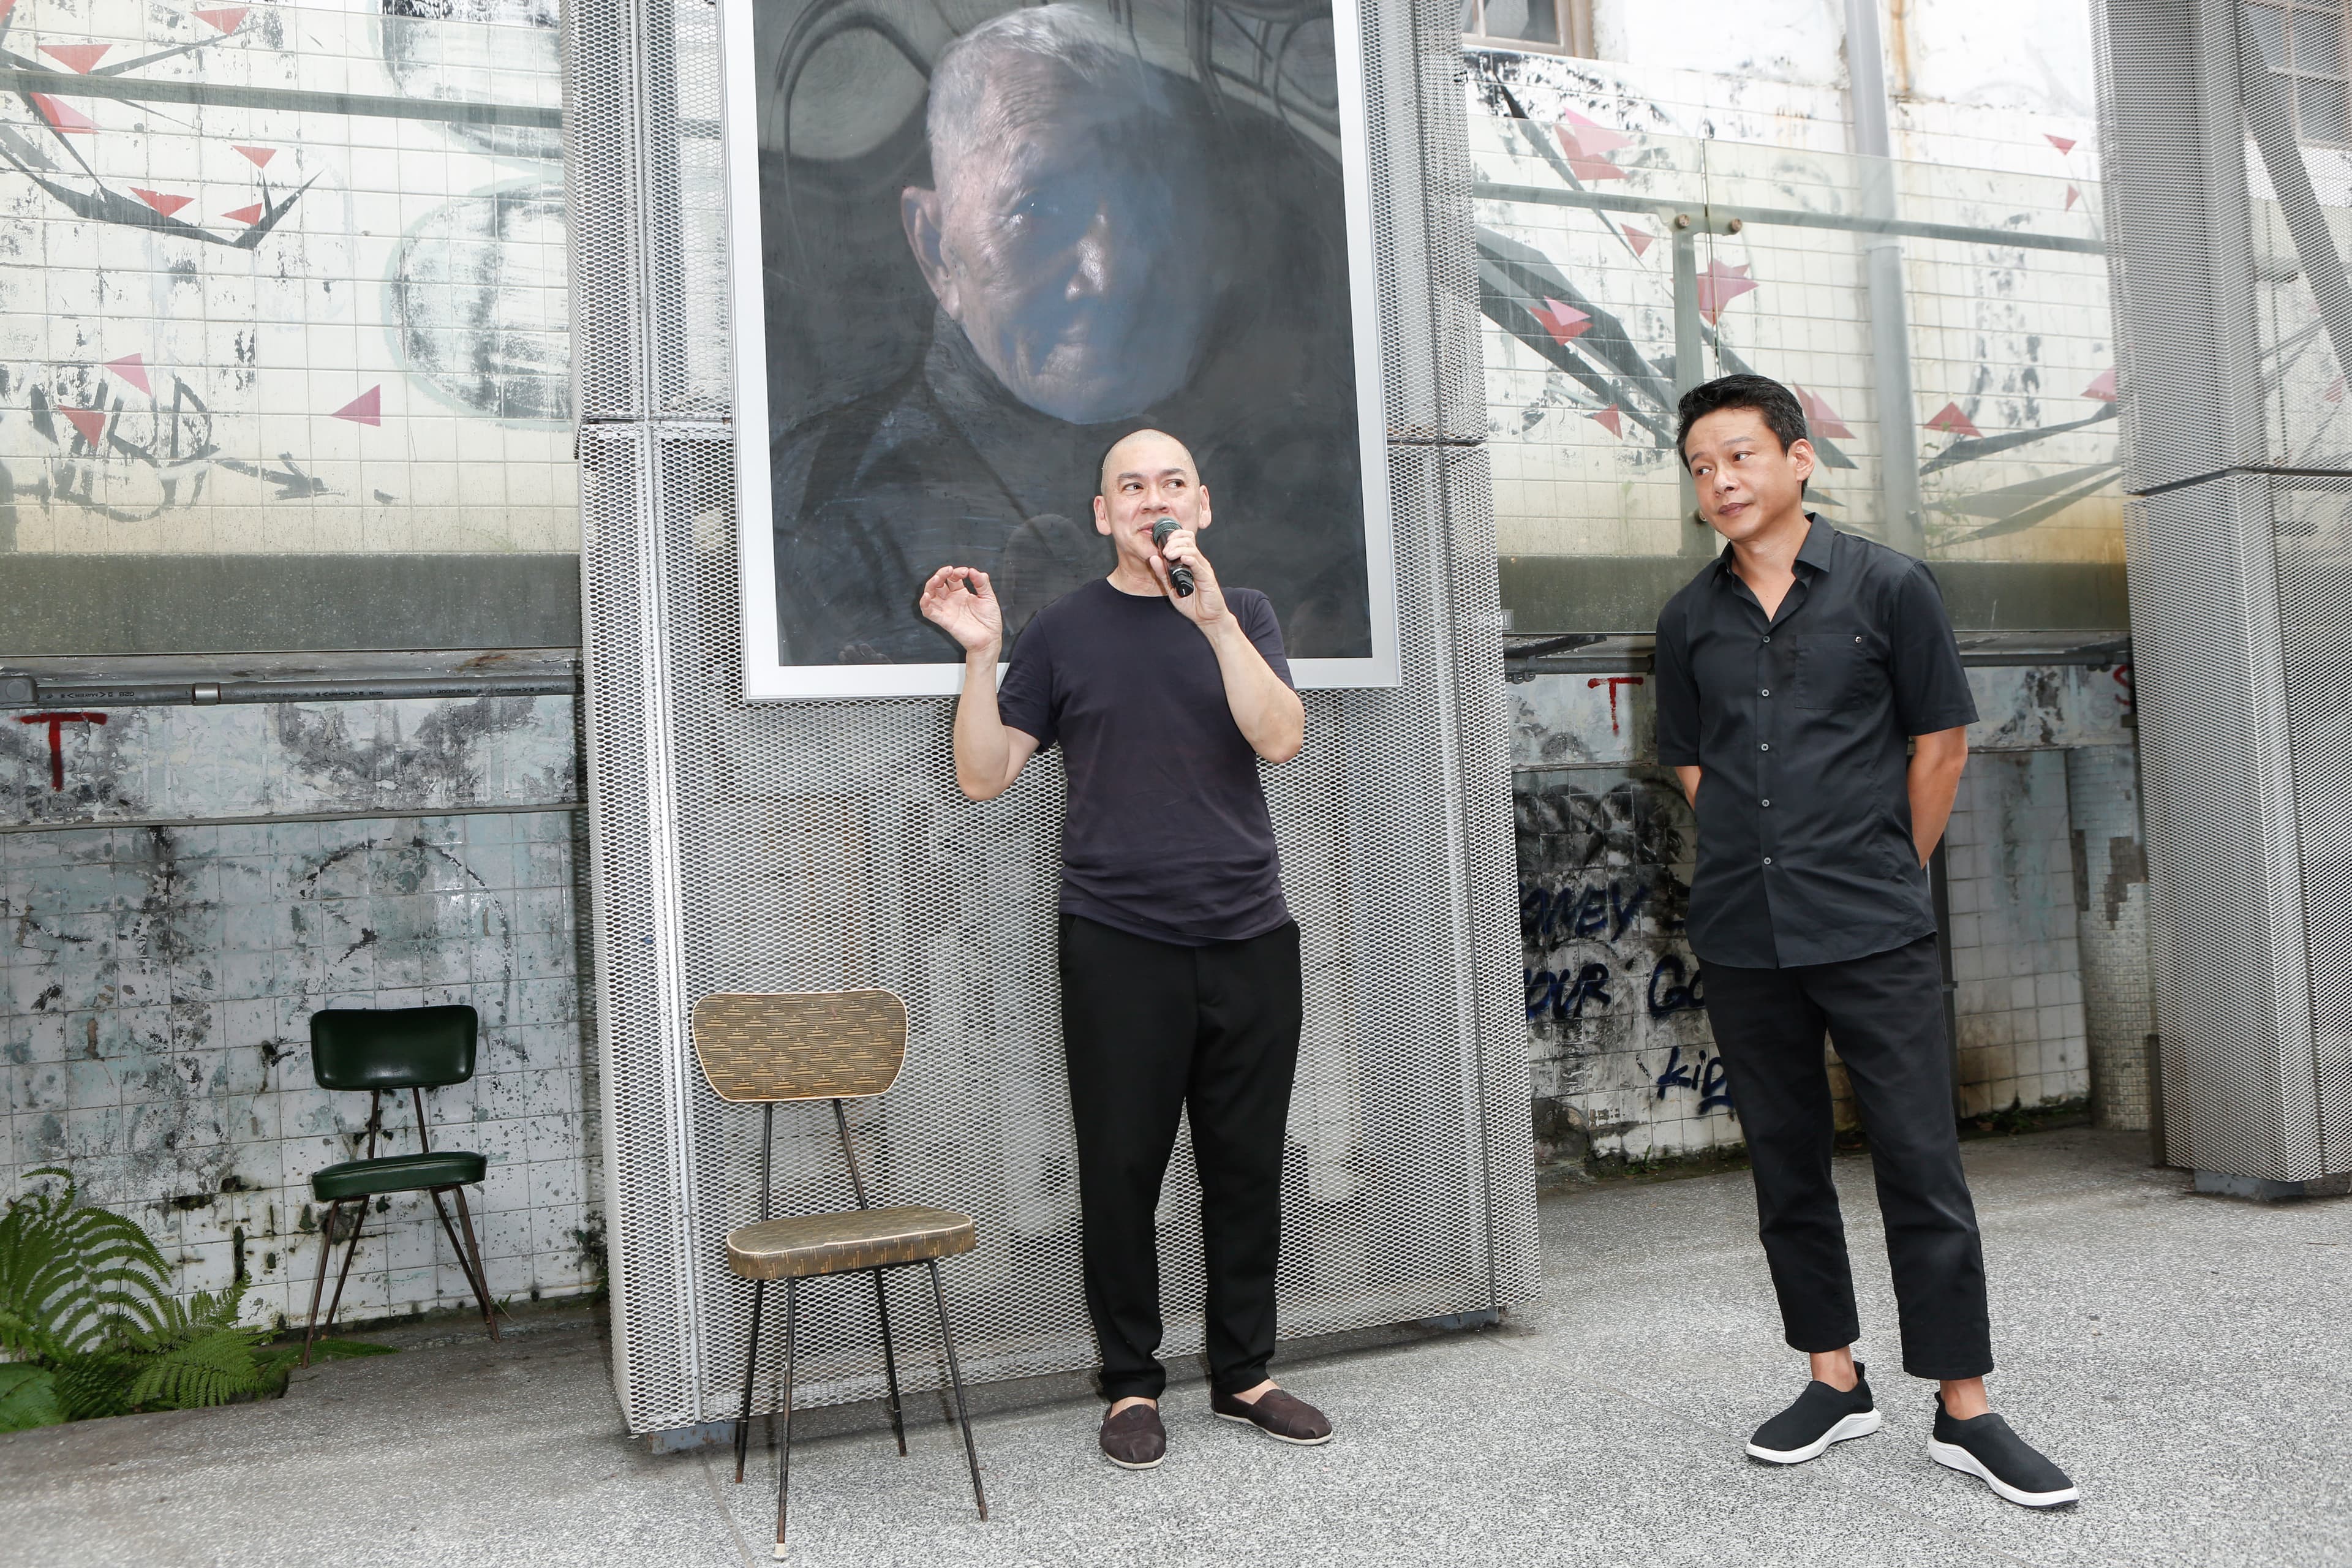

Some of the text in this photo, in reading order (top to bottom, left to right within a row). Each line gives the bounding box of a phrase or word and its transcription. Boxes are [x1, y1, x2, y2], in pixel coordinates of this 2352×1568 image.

[1587, 677, 1644, 737] T
[15, 712, 108, 792] T
[1519, 881, 1646, 942] ONEY
[1523, 963, 1610, 1019] OUR
